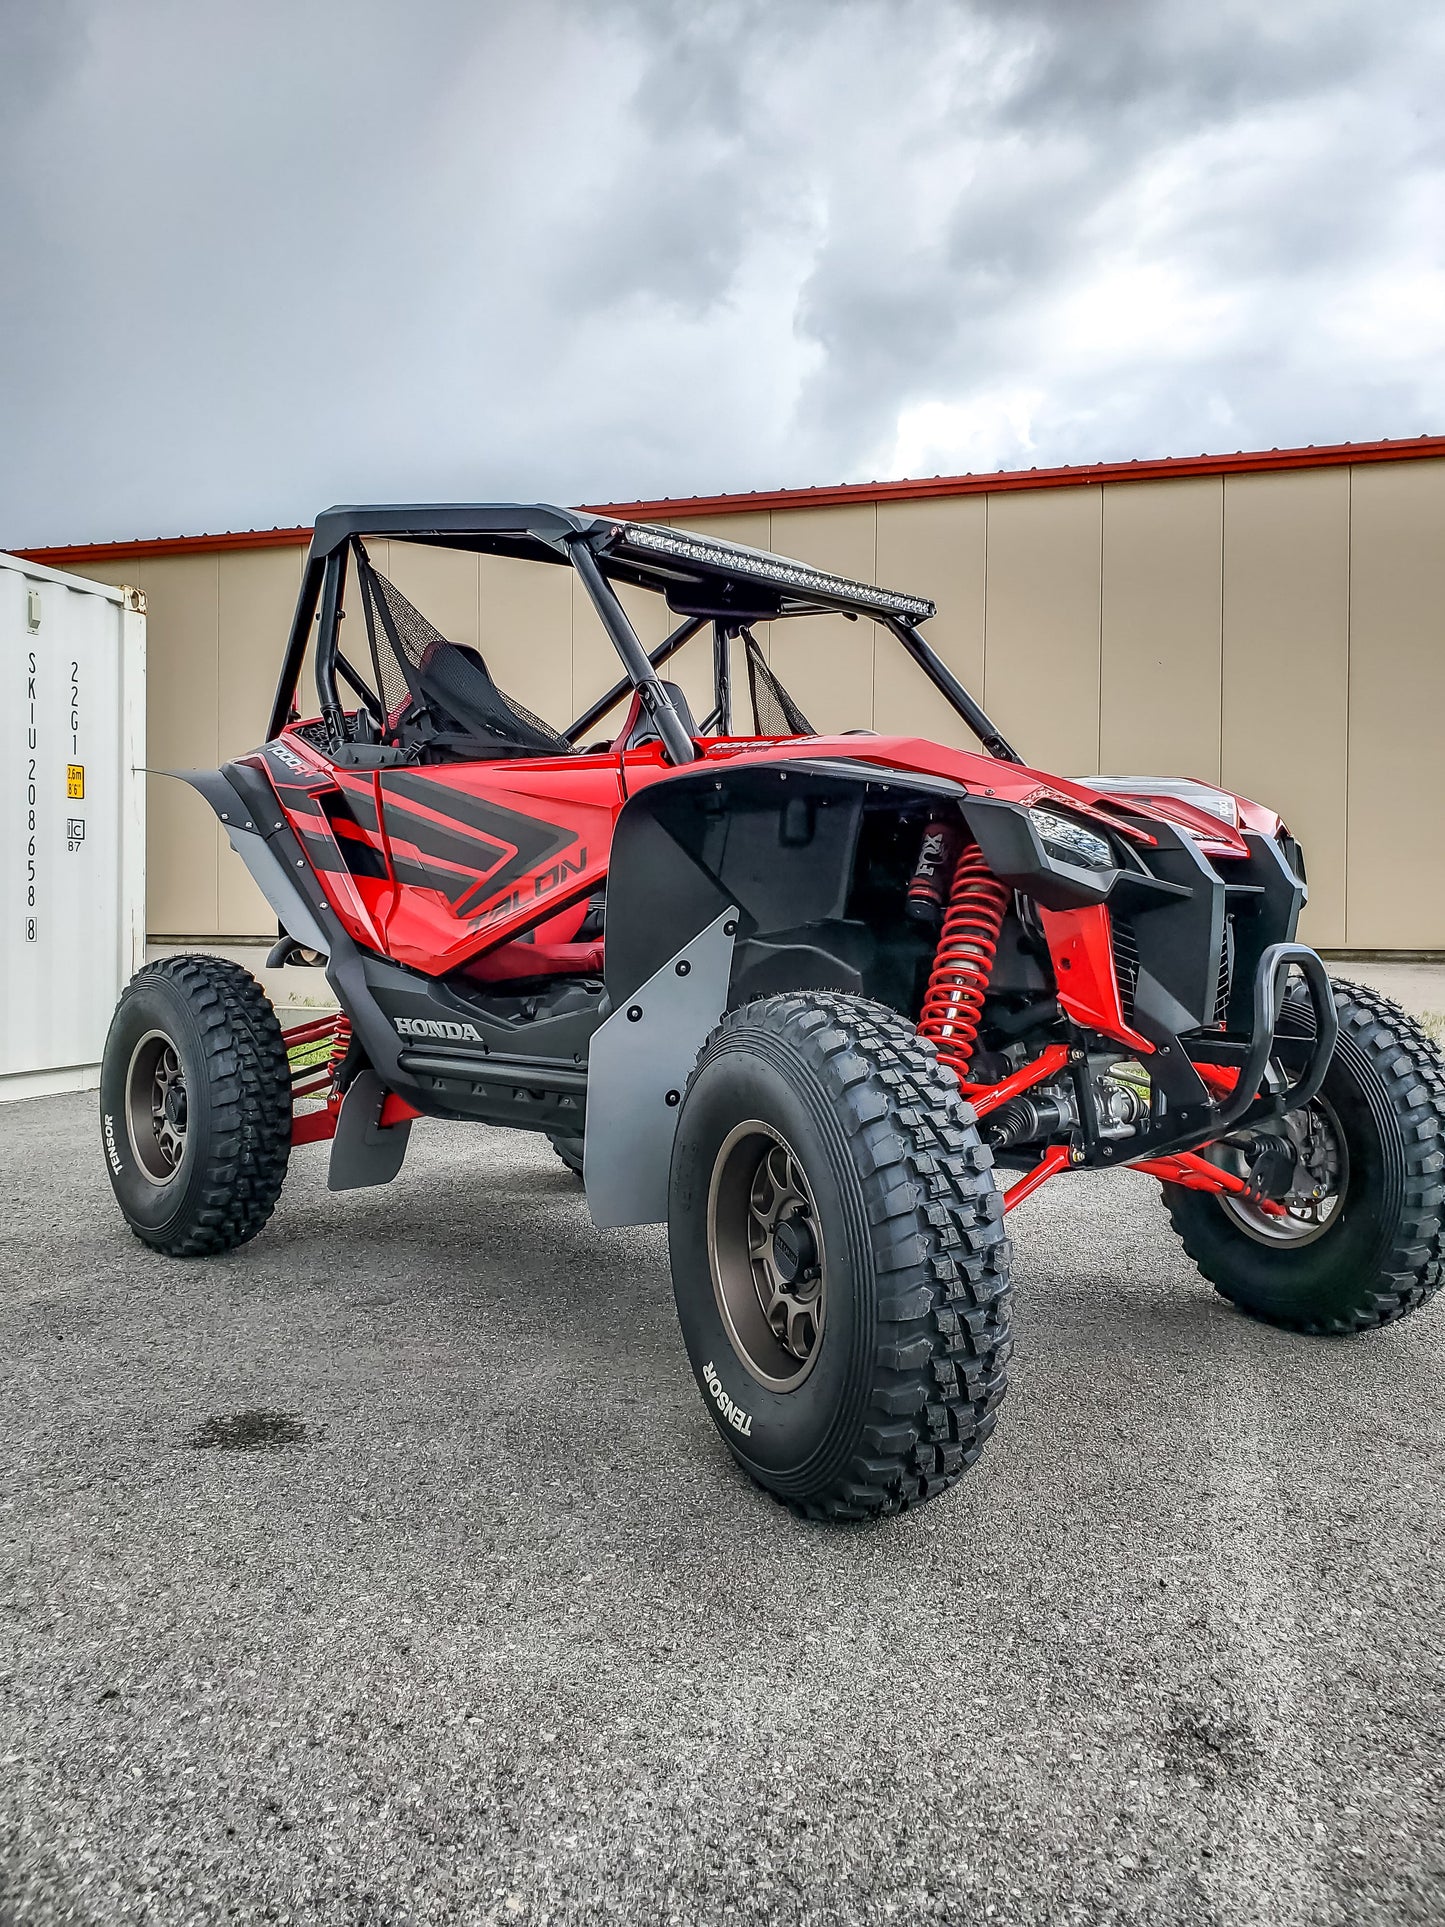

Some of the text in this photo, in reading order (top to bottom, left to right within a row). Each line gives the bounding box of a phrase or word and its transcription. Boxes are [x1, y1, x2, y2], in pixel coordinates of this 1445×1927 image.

[71, 661, 79, 755] 22G1
[67, 841, 82, 853] 87
[915, 833, 944, 876] FOX
[466, 846, 588, 931] TALON
[393, 1017, 484, 1042] HONDA
[104, 1113, 123, 1176] TENSOR
[702, 1360, 753, 1437] TENSOR
